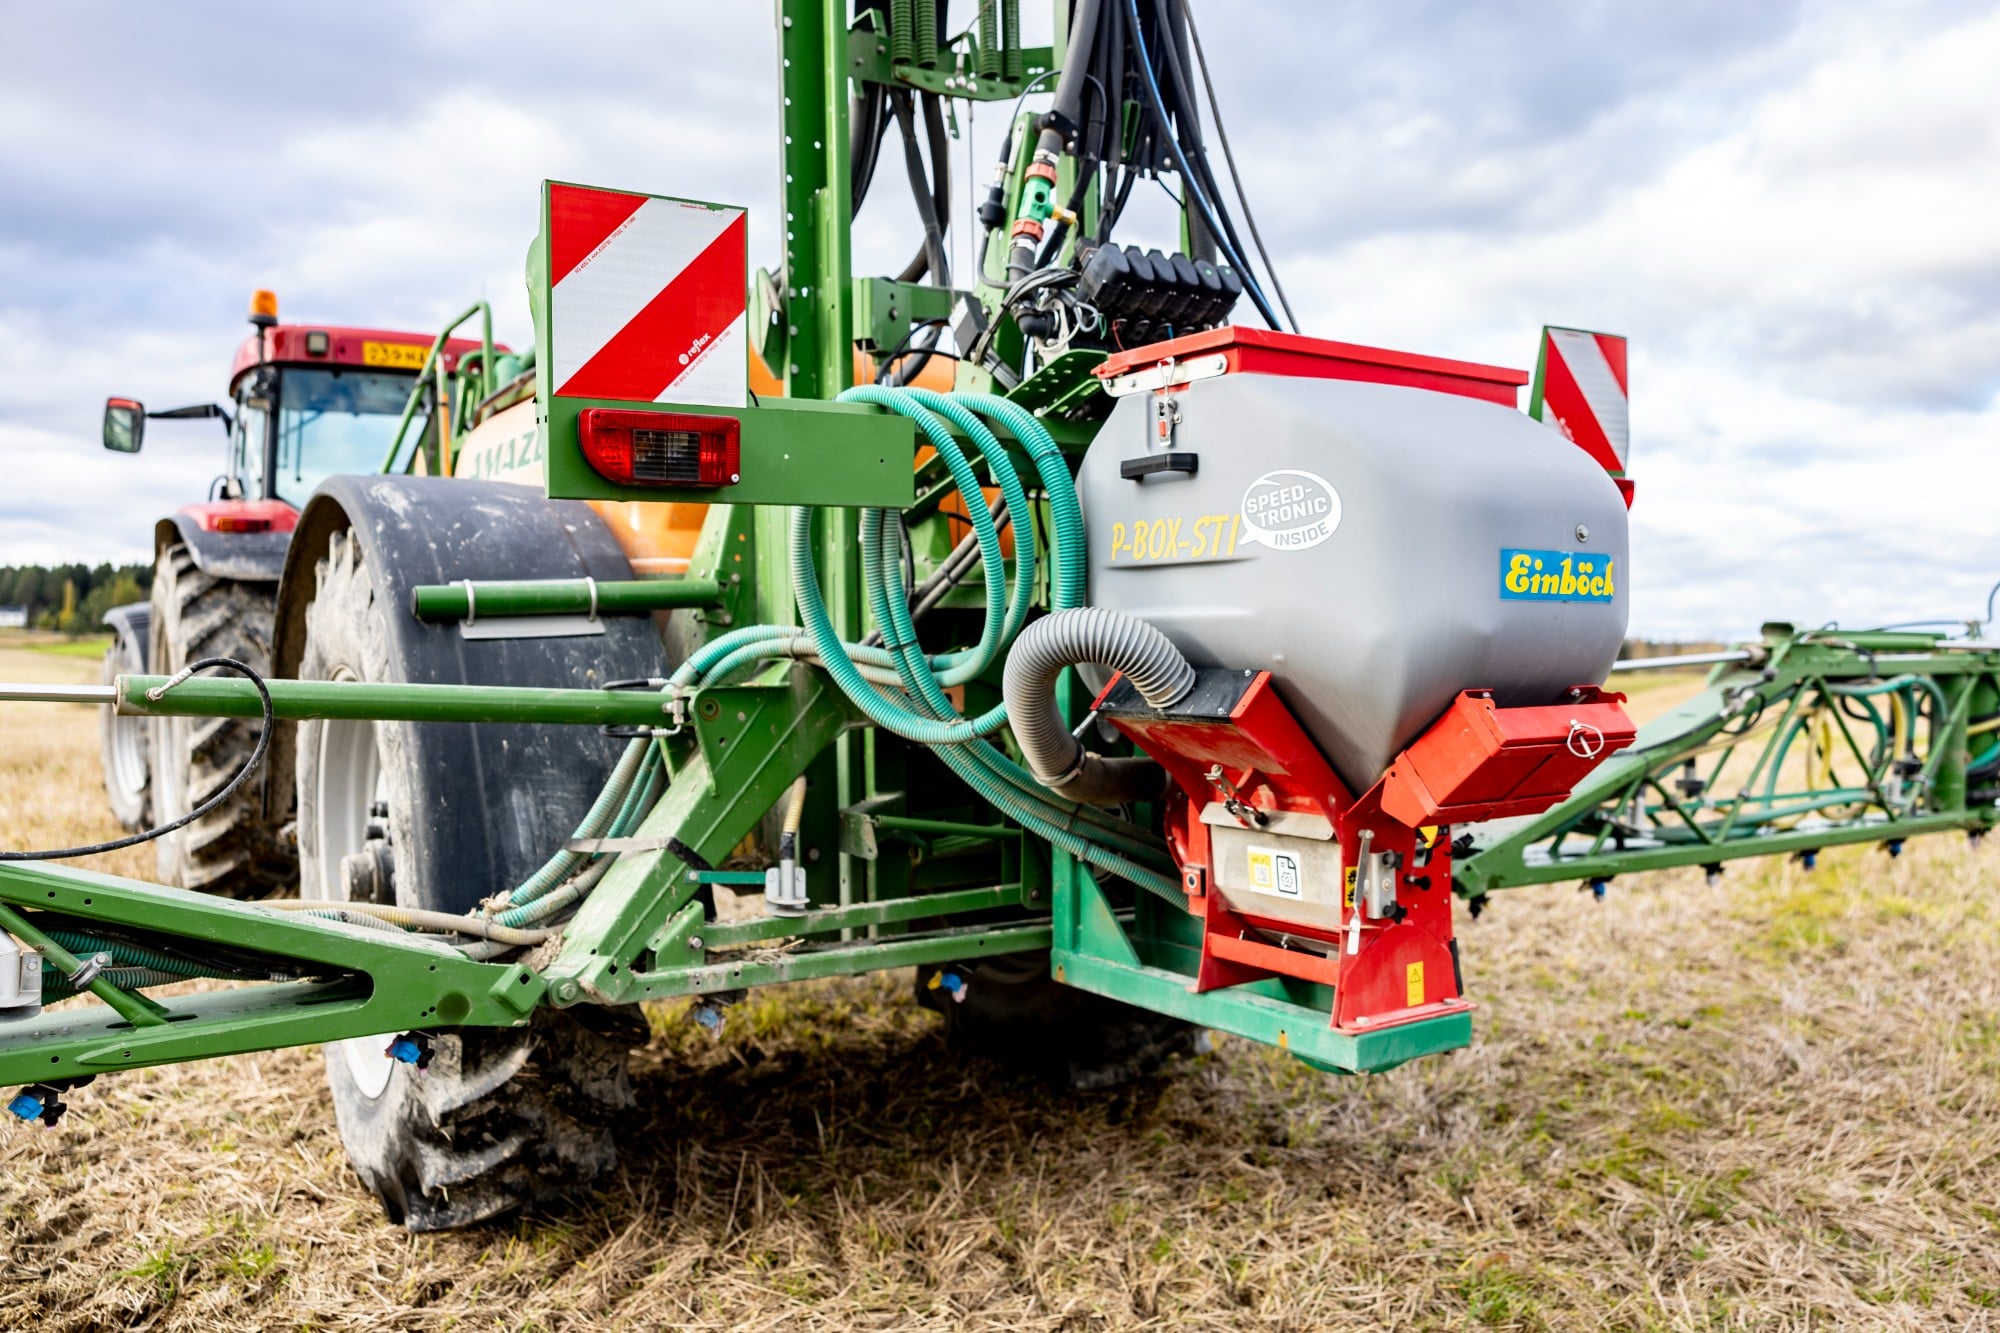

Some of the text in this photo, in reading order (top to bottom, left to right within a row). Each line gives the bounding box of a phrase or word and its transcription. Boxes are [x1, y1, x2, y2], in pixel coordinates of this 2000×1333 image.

[687, 332, 711, 357] reflex
[1246, 484, 1313, 514] SPEED-
[1257, 496, 1328, 528] TRONIC
[1111, 513, 1241, 561] P-BOX-STI
[1274, 521, 1329, 546] INSIDE
